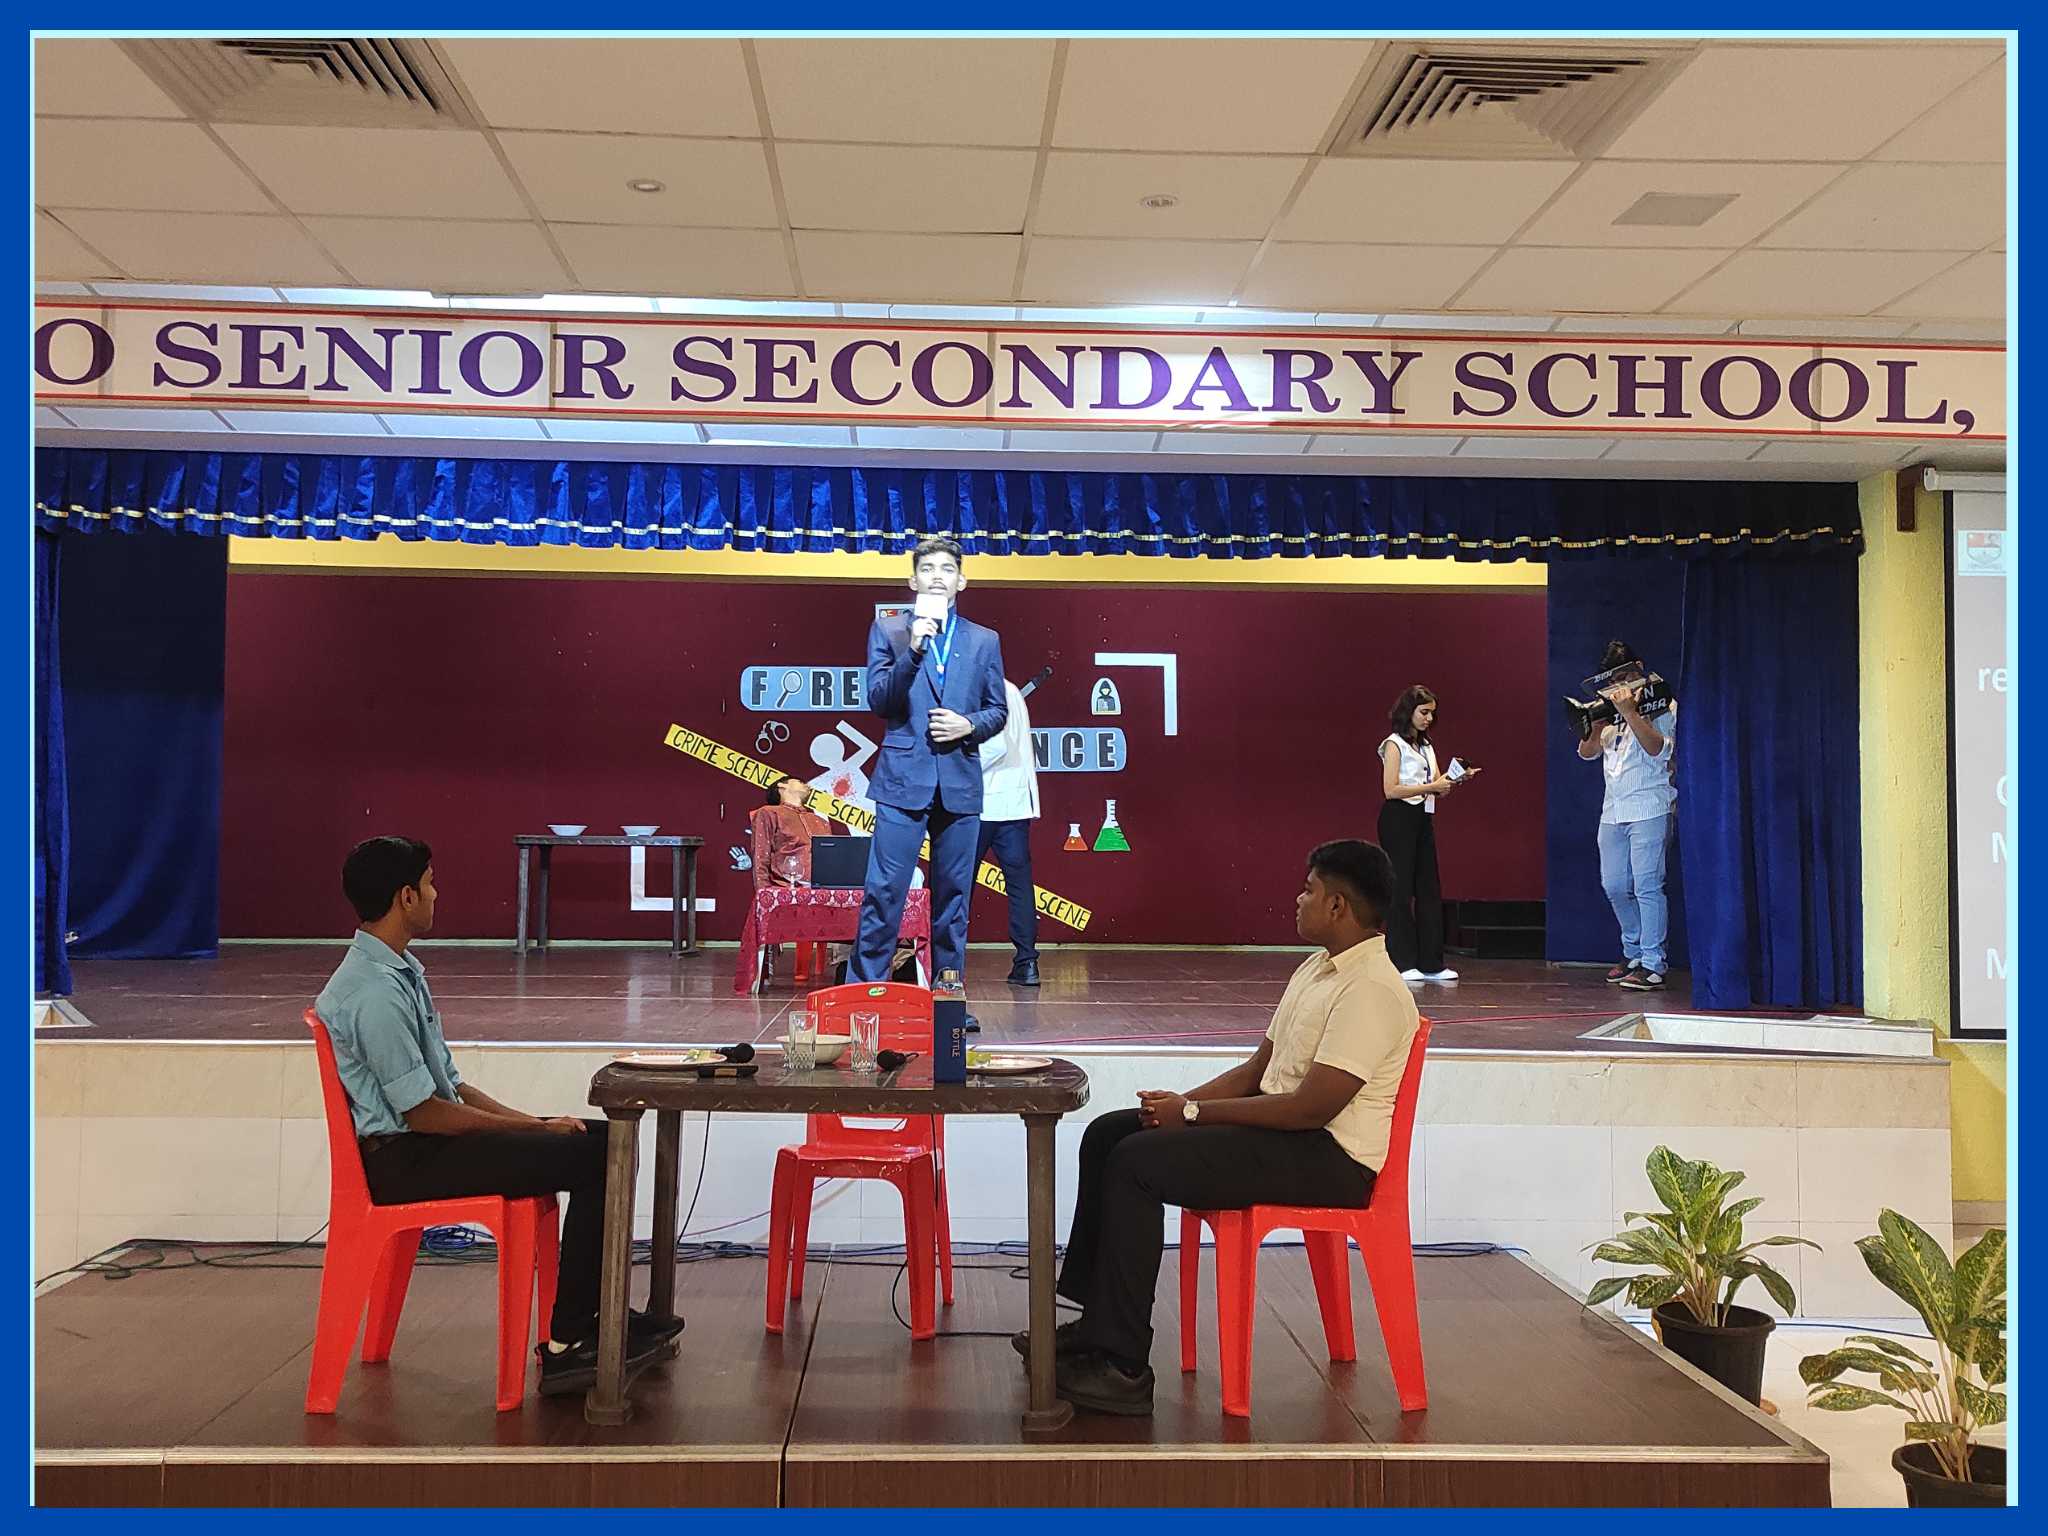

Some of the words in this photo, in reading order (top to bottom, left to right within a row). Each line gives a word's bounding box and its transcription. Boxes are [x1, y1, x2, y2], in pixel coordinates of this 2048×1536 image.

[153, 320, 634, 400] SENIOR
[671, 335, 1423, 414] SECONDARY
[1453, 352, 1976, 436] SCHOOL,
[751, 670, 860, 708] FORE
[1031, 732, 1116, 769] NCE
[673, 729, 723, 765] CRIME
[724, 752, 779, 787] SCENE
[1036, 891, 1091, 929] SCENE
